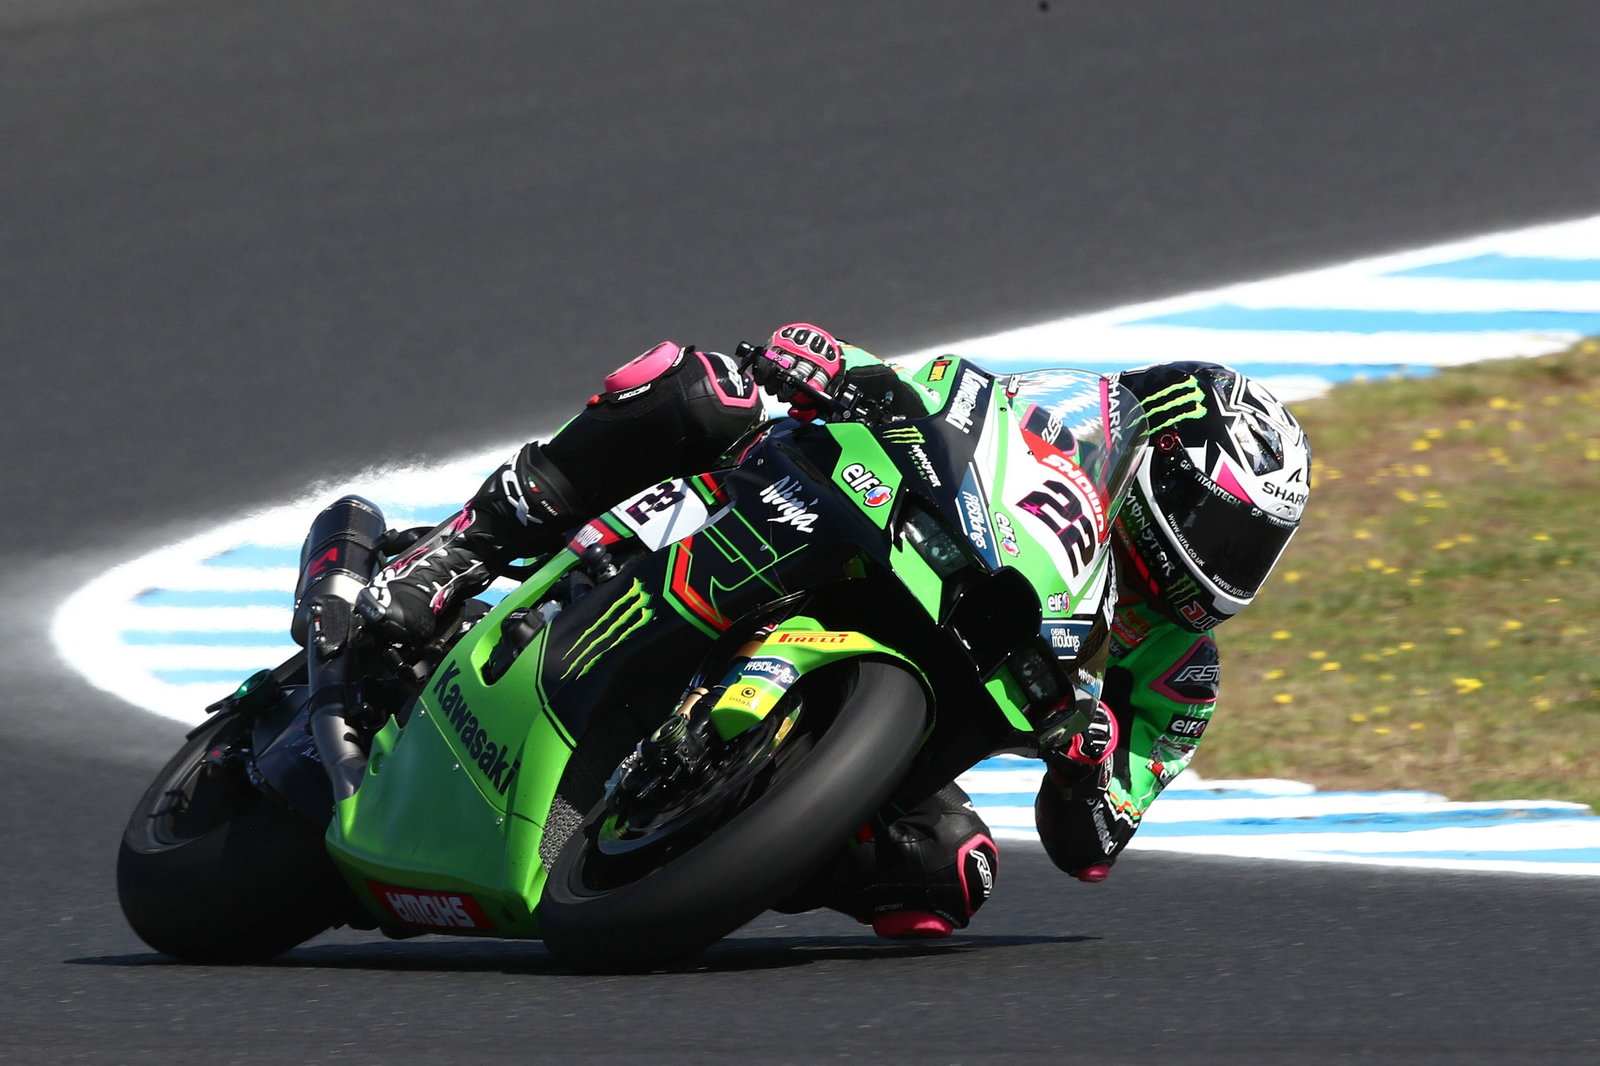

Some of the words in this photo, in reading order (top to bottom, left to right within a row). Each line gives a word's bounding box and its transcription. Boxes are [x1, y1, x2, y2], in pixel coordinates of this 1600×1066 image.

[945, 368, 990, 434] Kawasaki
[842, 462, 880, 495] elf
[911, 444, 942, 487] MONSTER
[1180, 459, 1192, 471] GP
[1194, 472, 1242, 507] TITANTECH
[760, 475, 819, 533] Ninja
[995, 512, 1016, 542] elf
[1015, 480, 1095, 578] 22
[1126, 487, 1176, 577] MONSTER
[1047, 593, 1065, 612] elf
[778, 633, 849, 643] PIRELLI
[432, 660, 520, 796] Kawasaki
[1171, 719, 1200, 734] elf
